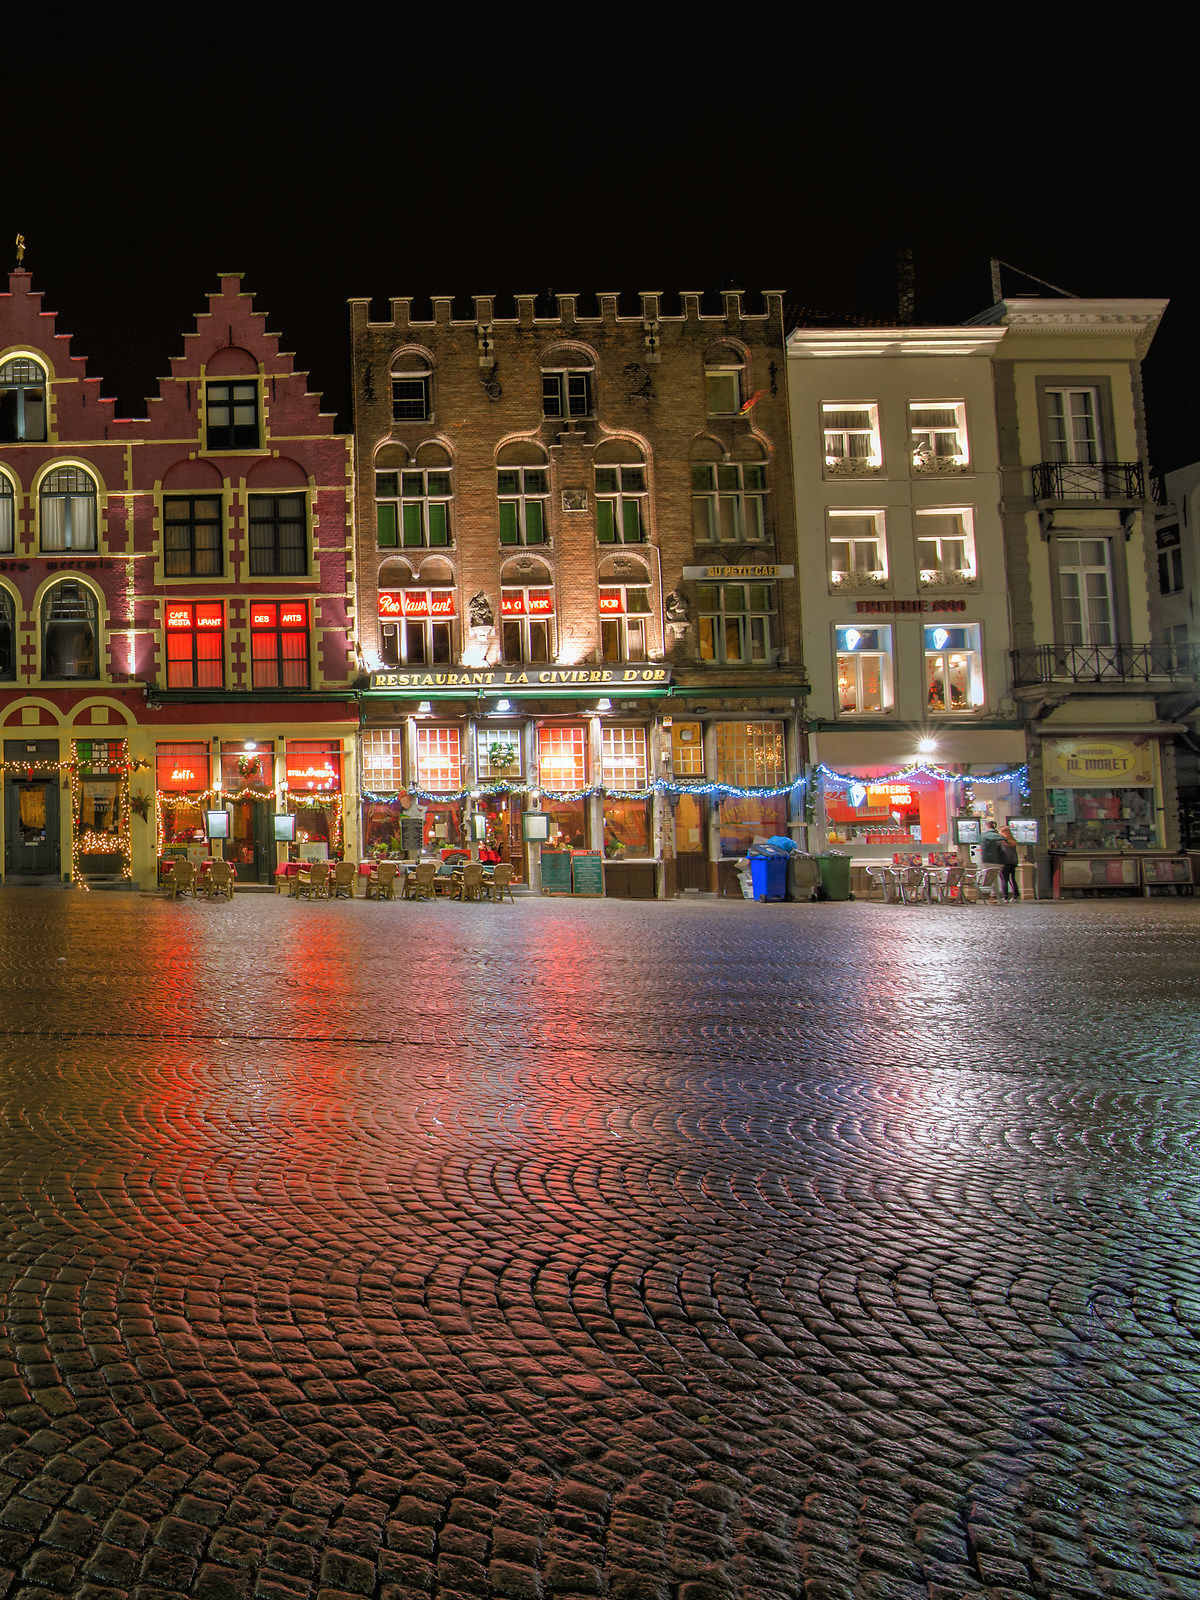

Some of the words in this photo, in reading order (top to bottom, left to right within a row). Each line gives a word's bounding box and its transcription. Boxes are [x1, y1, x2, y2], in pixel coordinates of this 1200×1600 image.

[707, 566, 721, 577] AU
[724, 566, 753, 577] PETIT
[755, 565, 780, 576] CAFE
[502, 601, 511, 609] LA
[856, 600, 929, 614] FRITERIE
[929, 599, 966, 613] 1900
[254, 615, 269, 623] DES
[282, 614, 302, 622] ARTS
[375, 672, 495, 686] RESTAURANT
[504, 672, 529, 684] LA
[539, 670, 612, 683] CIVIERE
[622, 669, 666, 681] D'OR
[869, 784, 911, 795] FRITERIE
[889, 794, 912, 805] 1900
